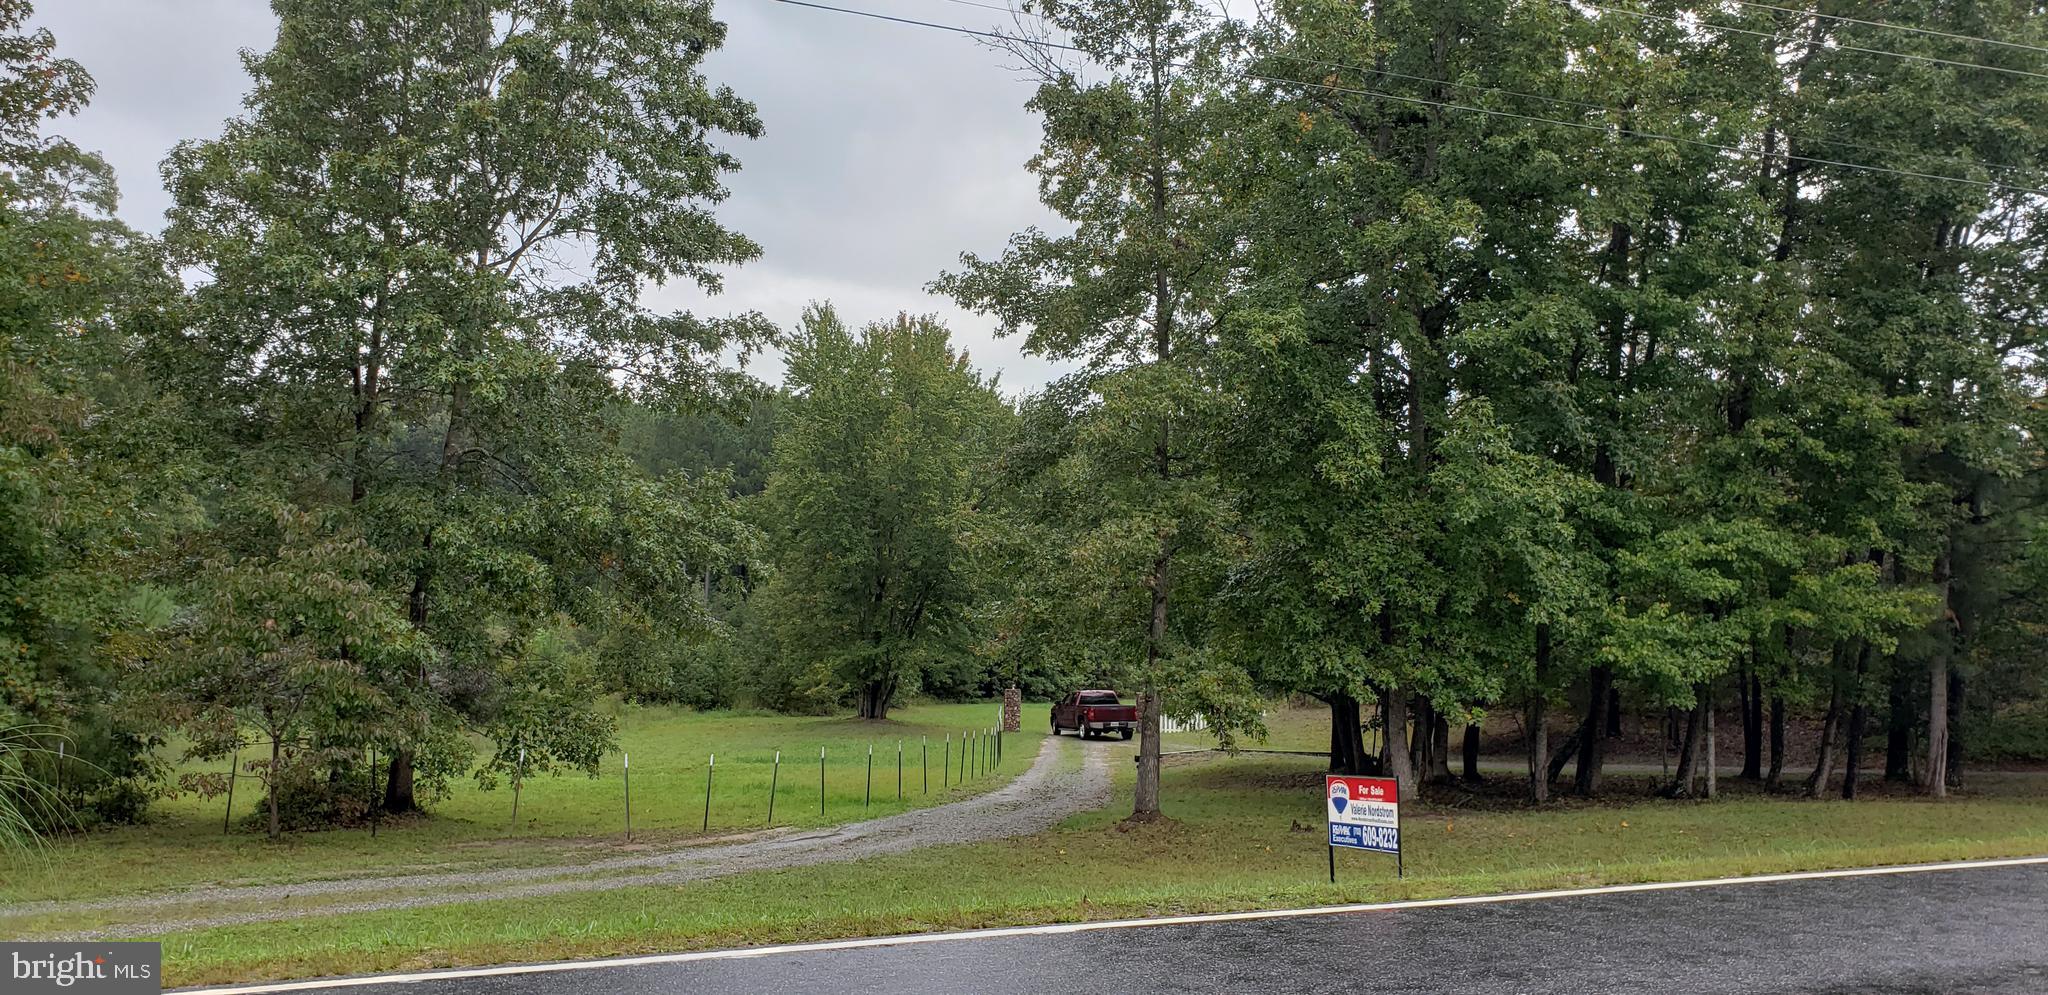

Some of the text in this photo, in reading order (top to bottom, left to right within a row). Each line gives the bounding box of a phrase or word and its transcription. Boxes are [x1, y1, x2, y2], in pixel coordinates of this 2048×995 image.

[1358, 785, 1384, 795] For Sale
[1351, 803, 1394, 818] Valerie Nordstrom
[1362, 825, 1398, 849] 609-8232
